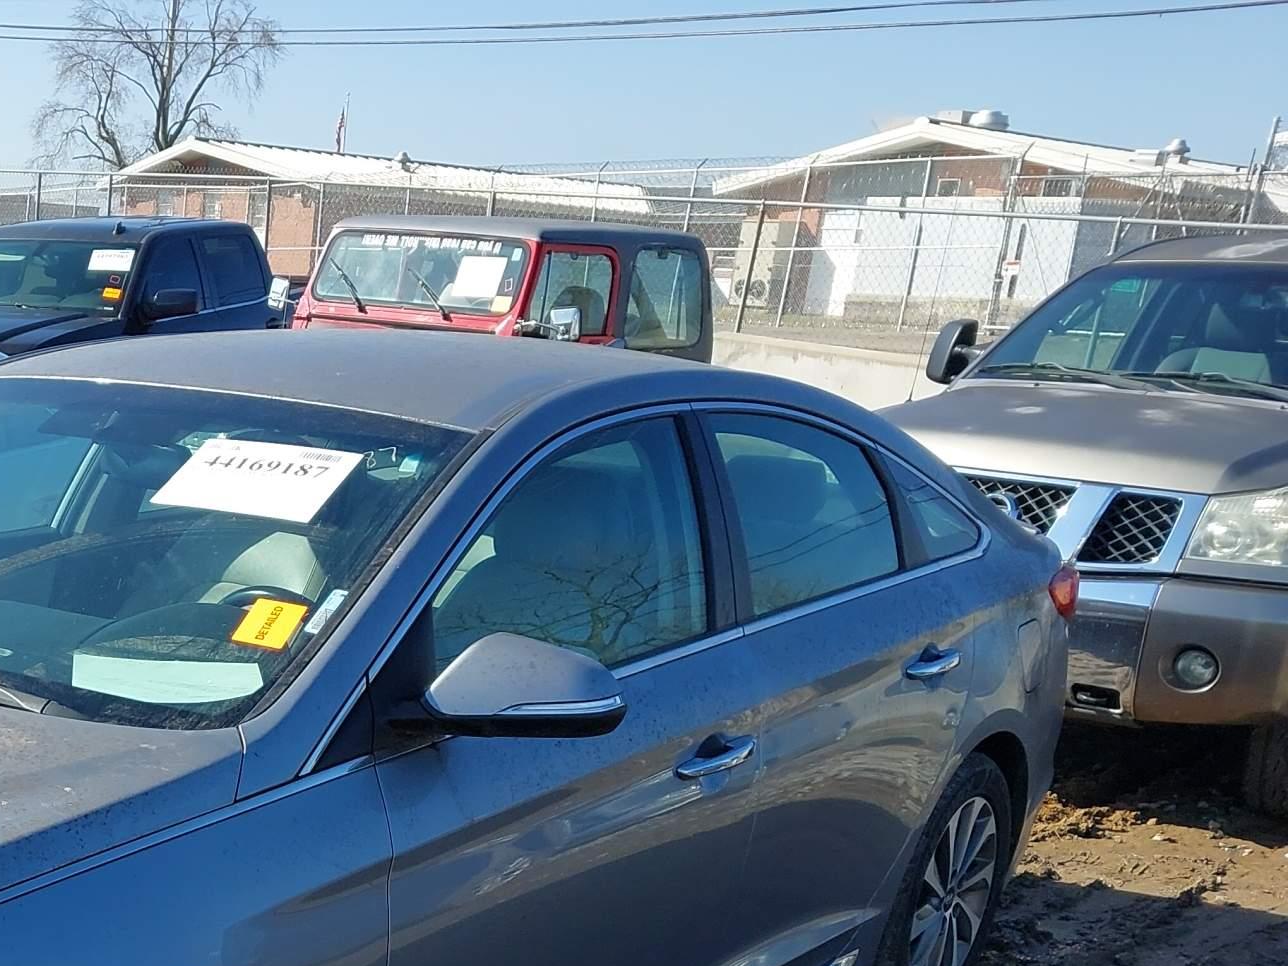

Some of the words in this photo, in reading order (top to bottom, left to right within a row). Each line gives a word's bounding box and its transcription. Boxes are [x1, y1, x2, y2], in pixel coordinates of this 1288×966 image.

[440, 238, 461, 249] read
[460, 239, 477, 250] can
[477, 240, 494, 251] you
[204, 455, 330, 478] 44169187
[255, 606, 284, 641] DETAILED
